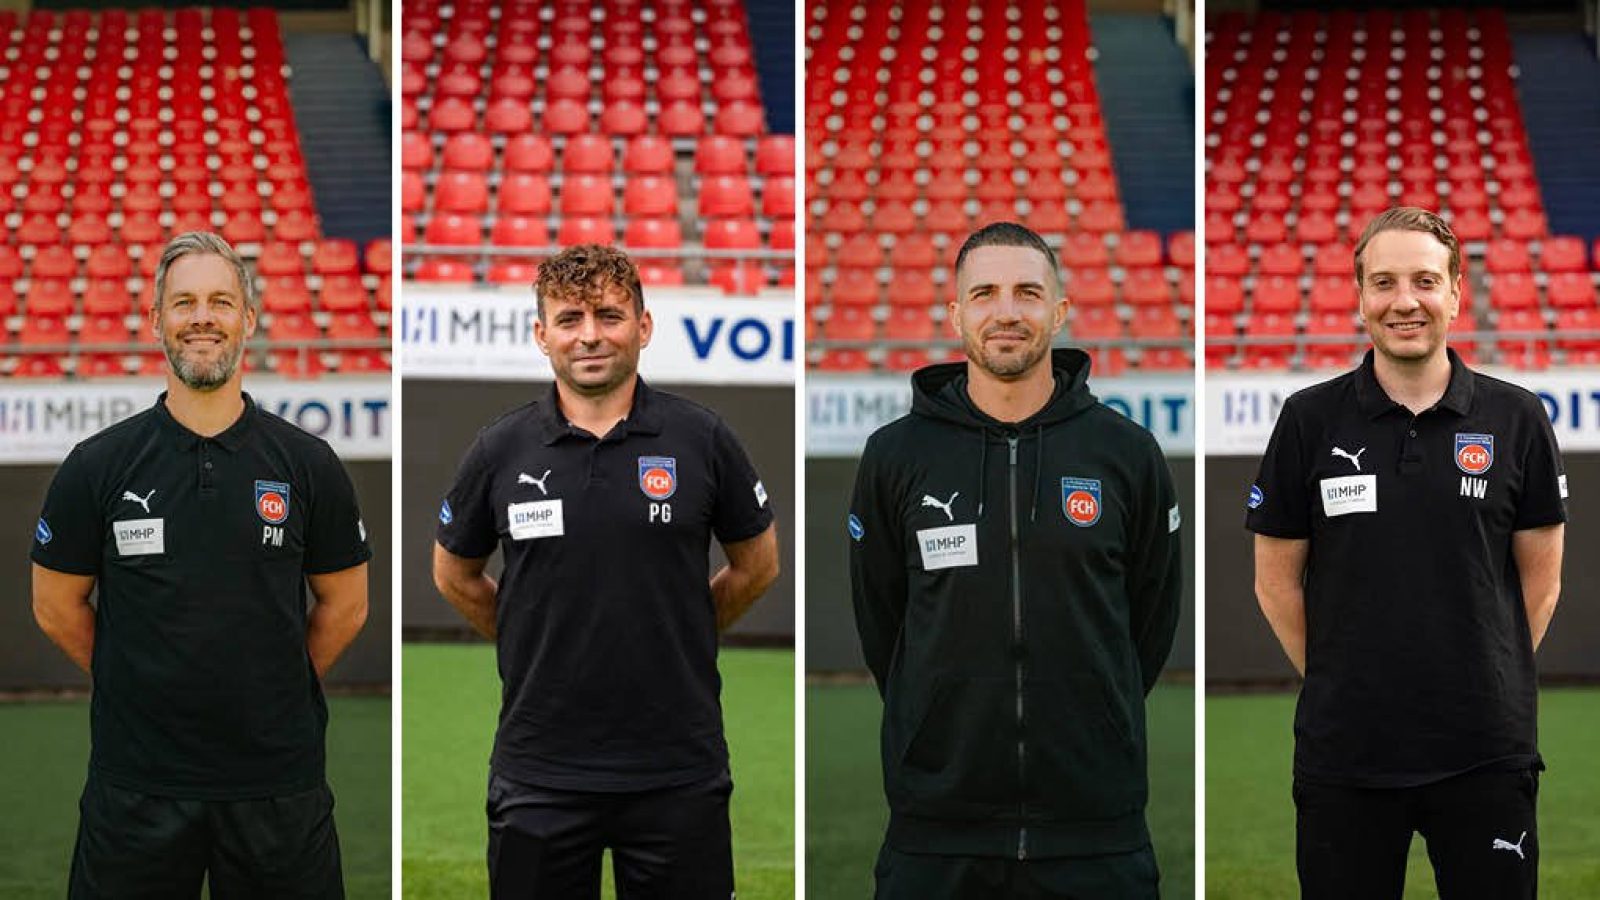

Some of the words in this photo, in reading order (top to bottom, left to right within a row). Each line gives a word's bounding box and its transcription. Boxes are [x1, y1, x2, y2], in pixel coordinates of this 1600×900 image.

[682, 317, 795, 361] VOI
[43, 398, 135, 432] MHP
[1463, 452, 1486, 464] FCH
[647, 476, 669, 490] FCH
[1460, 476, 1488, 500] NW
[1338, 484, 1367, 498] MHP
[262, 502, 283, 515] FCH
[649, 503, 672, 523] PG
[1070, 499, 1094, 515] FCH
[527, 510, 553, 522] MHP
[129, 527, 155, 541] MHP
[262, 526, 284, 547] PM
[937, 535, 966, 550] MHP
